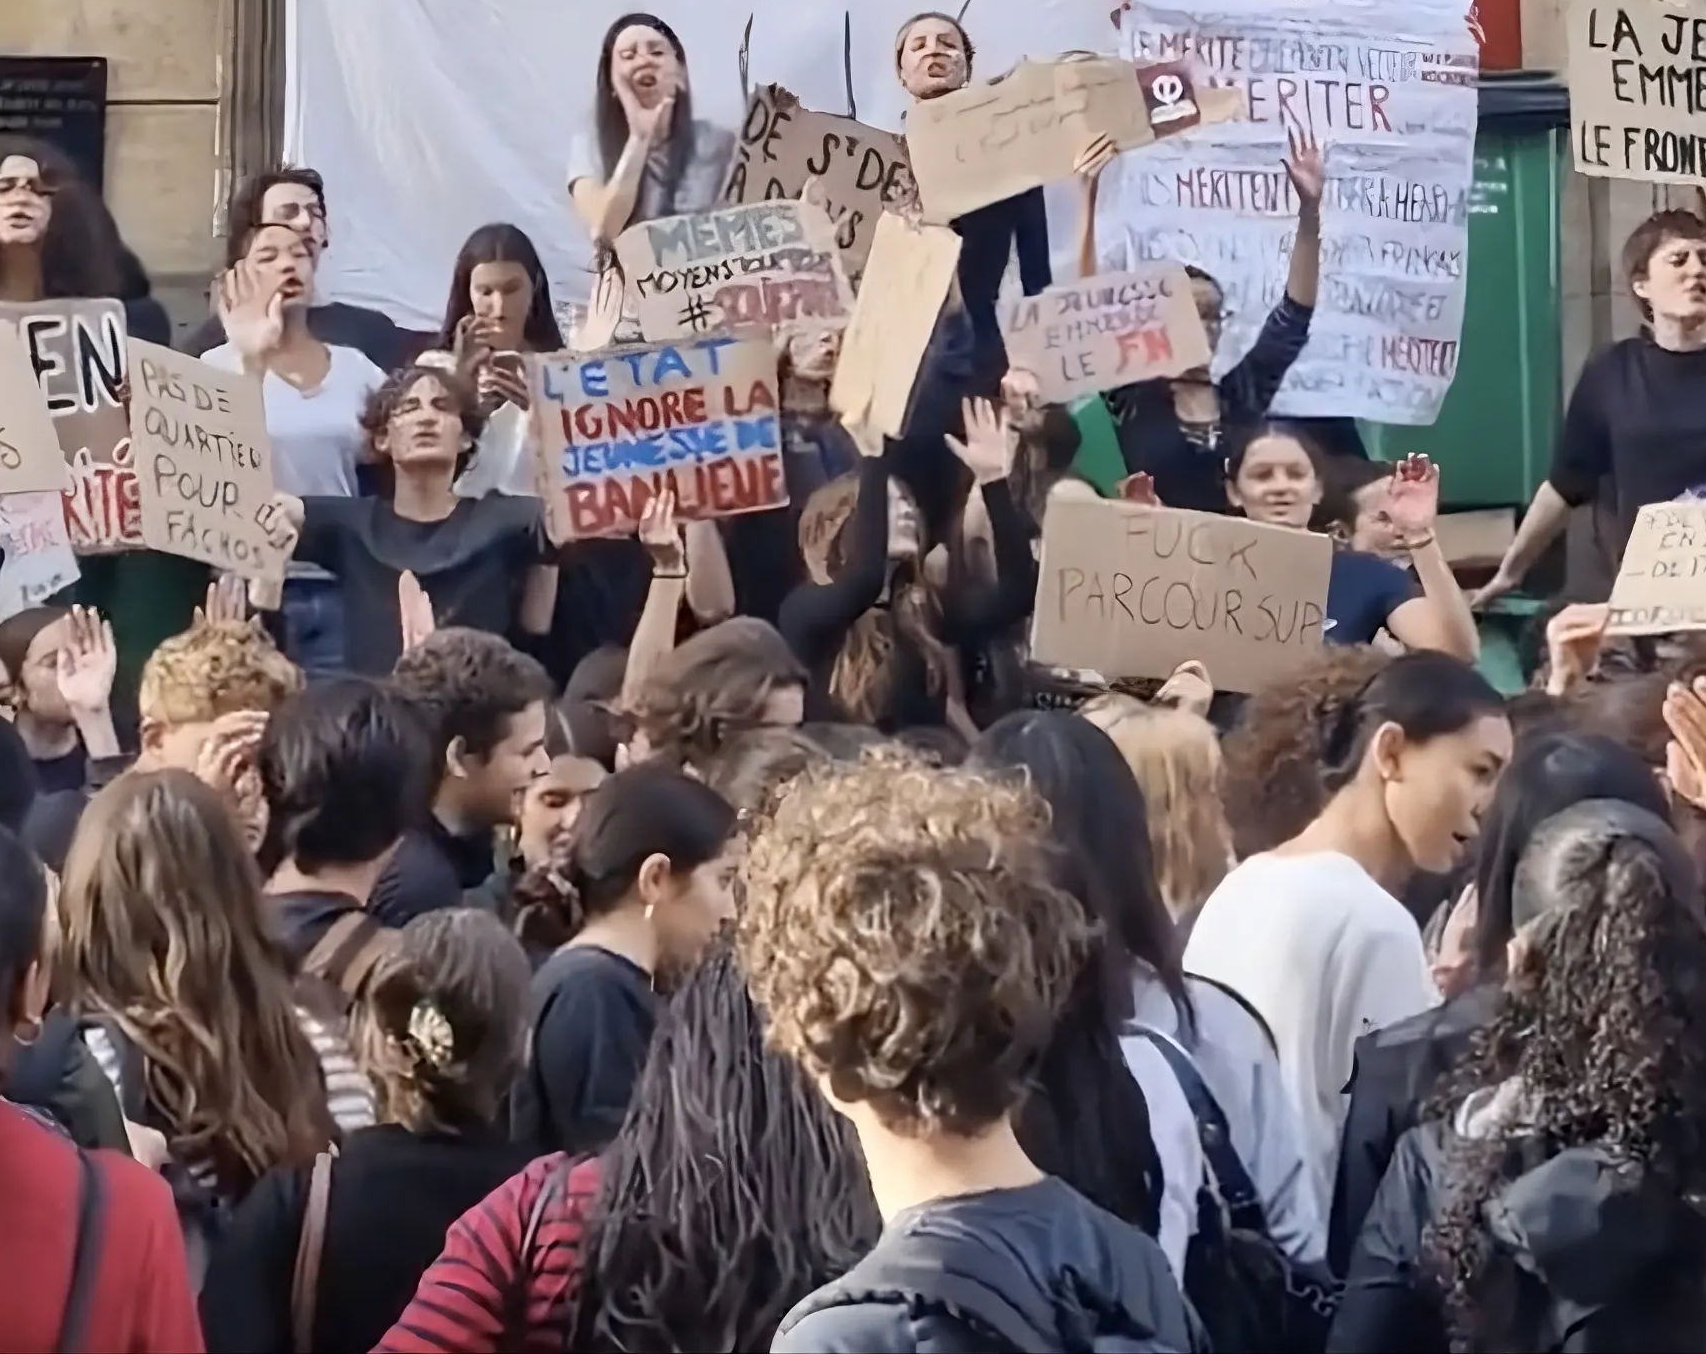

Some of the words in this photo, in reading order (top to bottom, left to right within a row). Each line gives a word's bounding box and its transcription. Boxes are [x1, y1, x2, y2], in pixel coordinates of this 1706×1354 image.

[1588, 7, 1644, 58] LA
[1205, 74, 1393, 134] ERITER
[1580, 120, 1612, 167] LE
[1061, 351, 1096, 381] LE
[193, 383, 232, 413] DE
[561, 387, 708, 447] IGNORE
[724, 380, 775, 417] LA
[154, 454, 244, 519] POUR
[166, 510, 265, 569] FACHOS
[1117, 510, 1259, 582] FUCK
